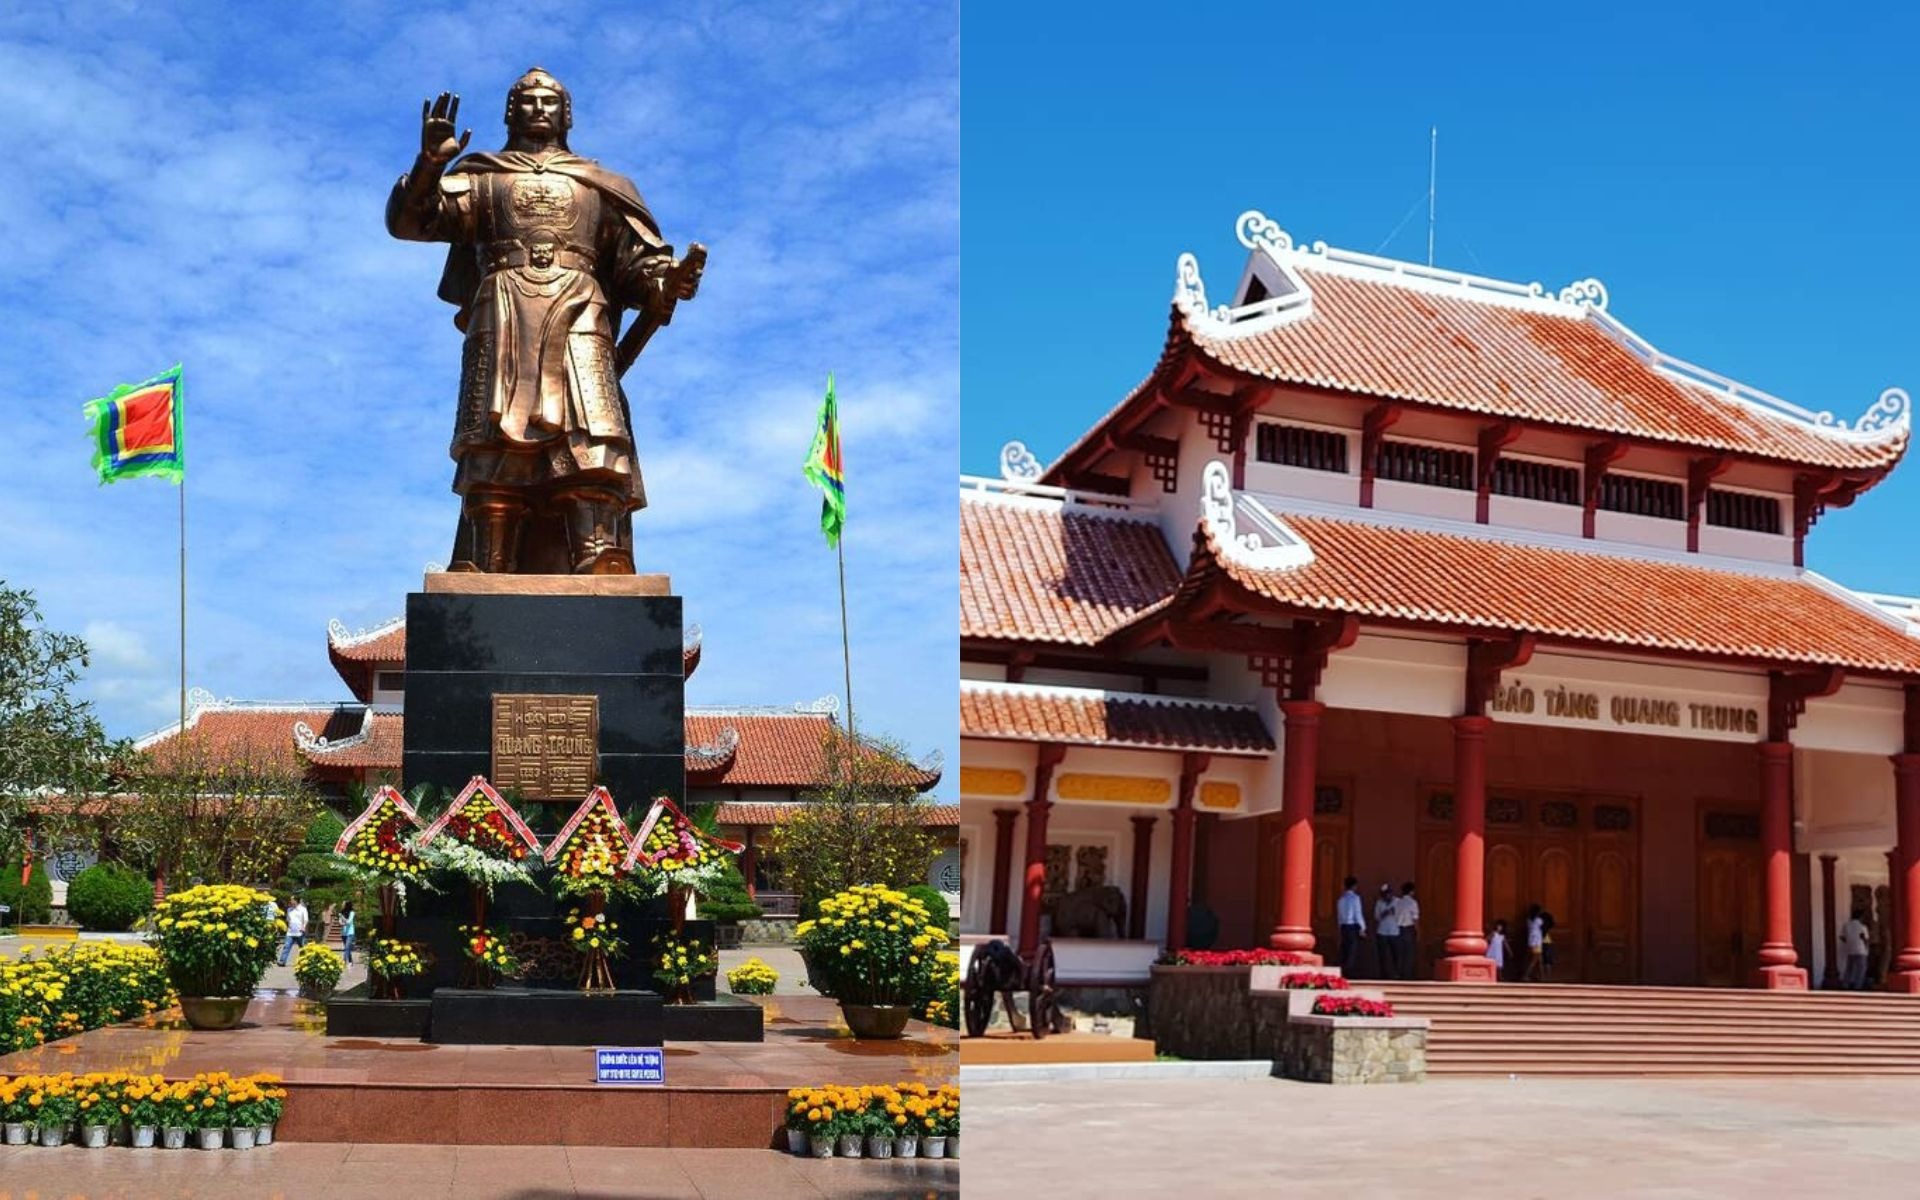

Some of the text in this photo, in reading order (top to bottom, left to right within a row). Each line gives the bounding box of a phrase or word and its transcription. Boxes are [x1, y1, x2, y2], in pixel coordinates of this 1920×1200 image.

[1492, 680, 1758, 734] BẢO TÀNG QUANG TRUNG
[496, 737, 593, 755] QUANG TRUNG
